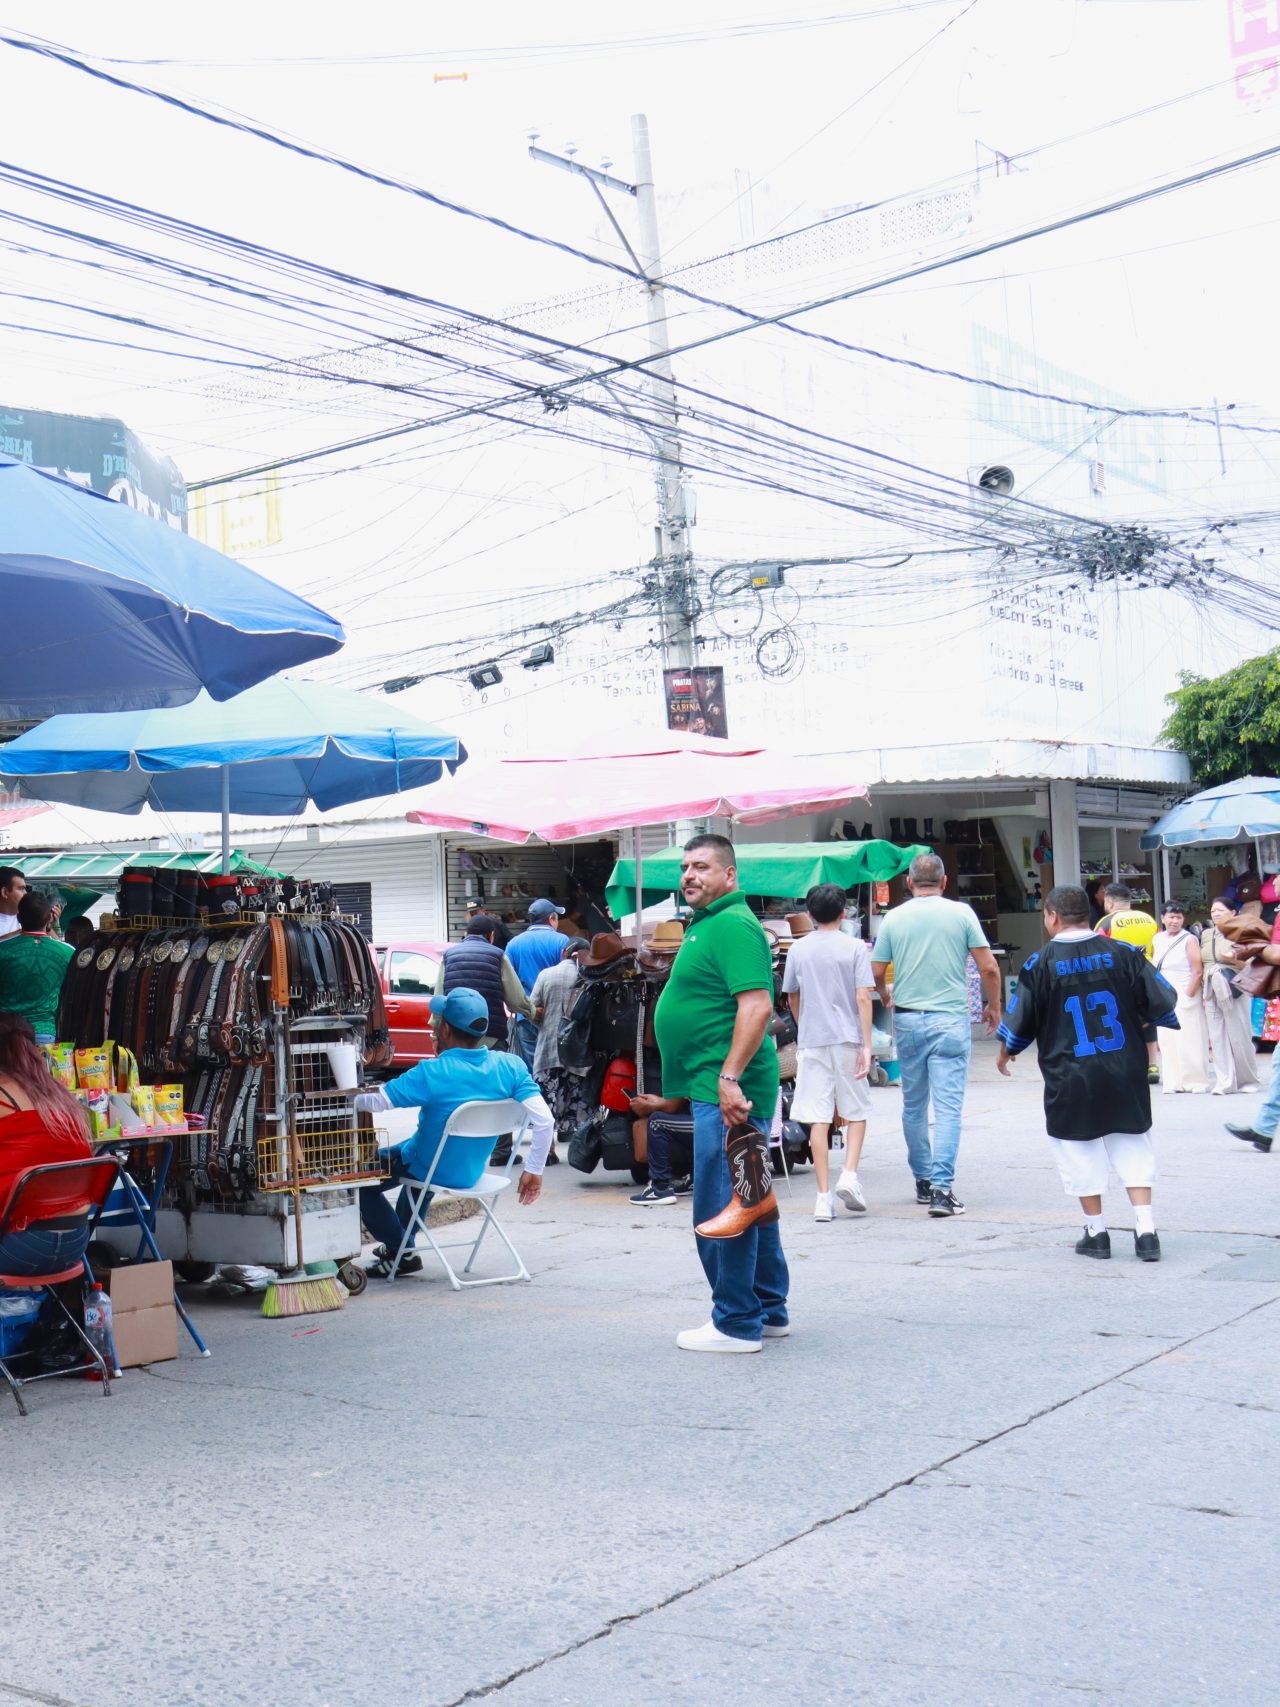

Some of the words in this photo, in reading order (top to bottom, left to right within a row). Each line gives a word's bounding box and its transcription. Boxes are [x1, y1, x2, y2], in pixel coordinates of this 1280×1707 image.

[671, 703, 701, 713] SABINA
[1116, 916, 1152, 929] Corona
[1055, 953, 1114, 977] GIANTS
[1064, 990, 1126, 1058] 13
